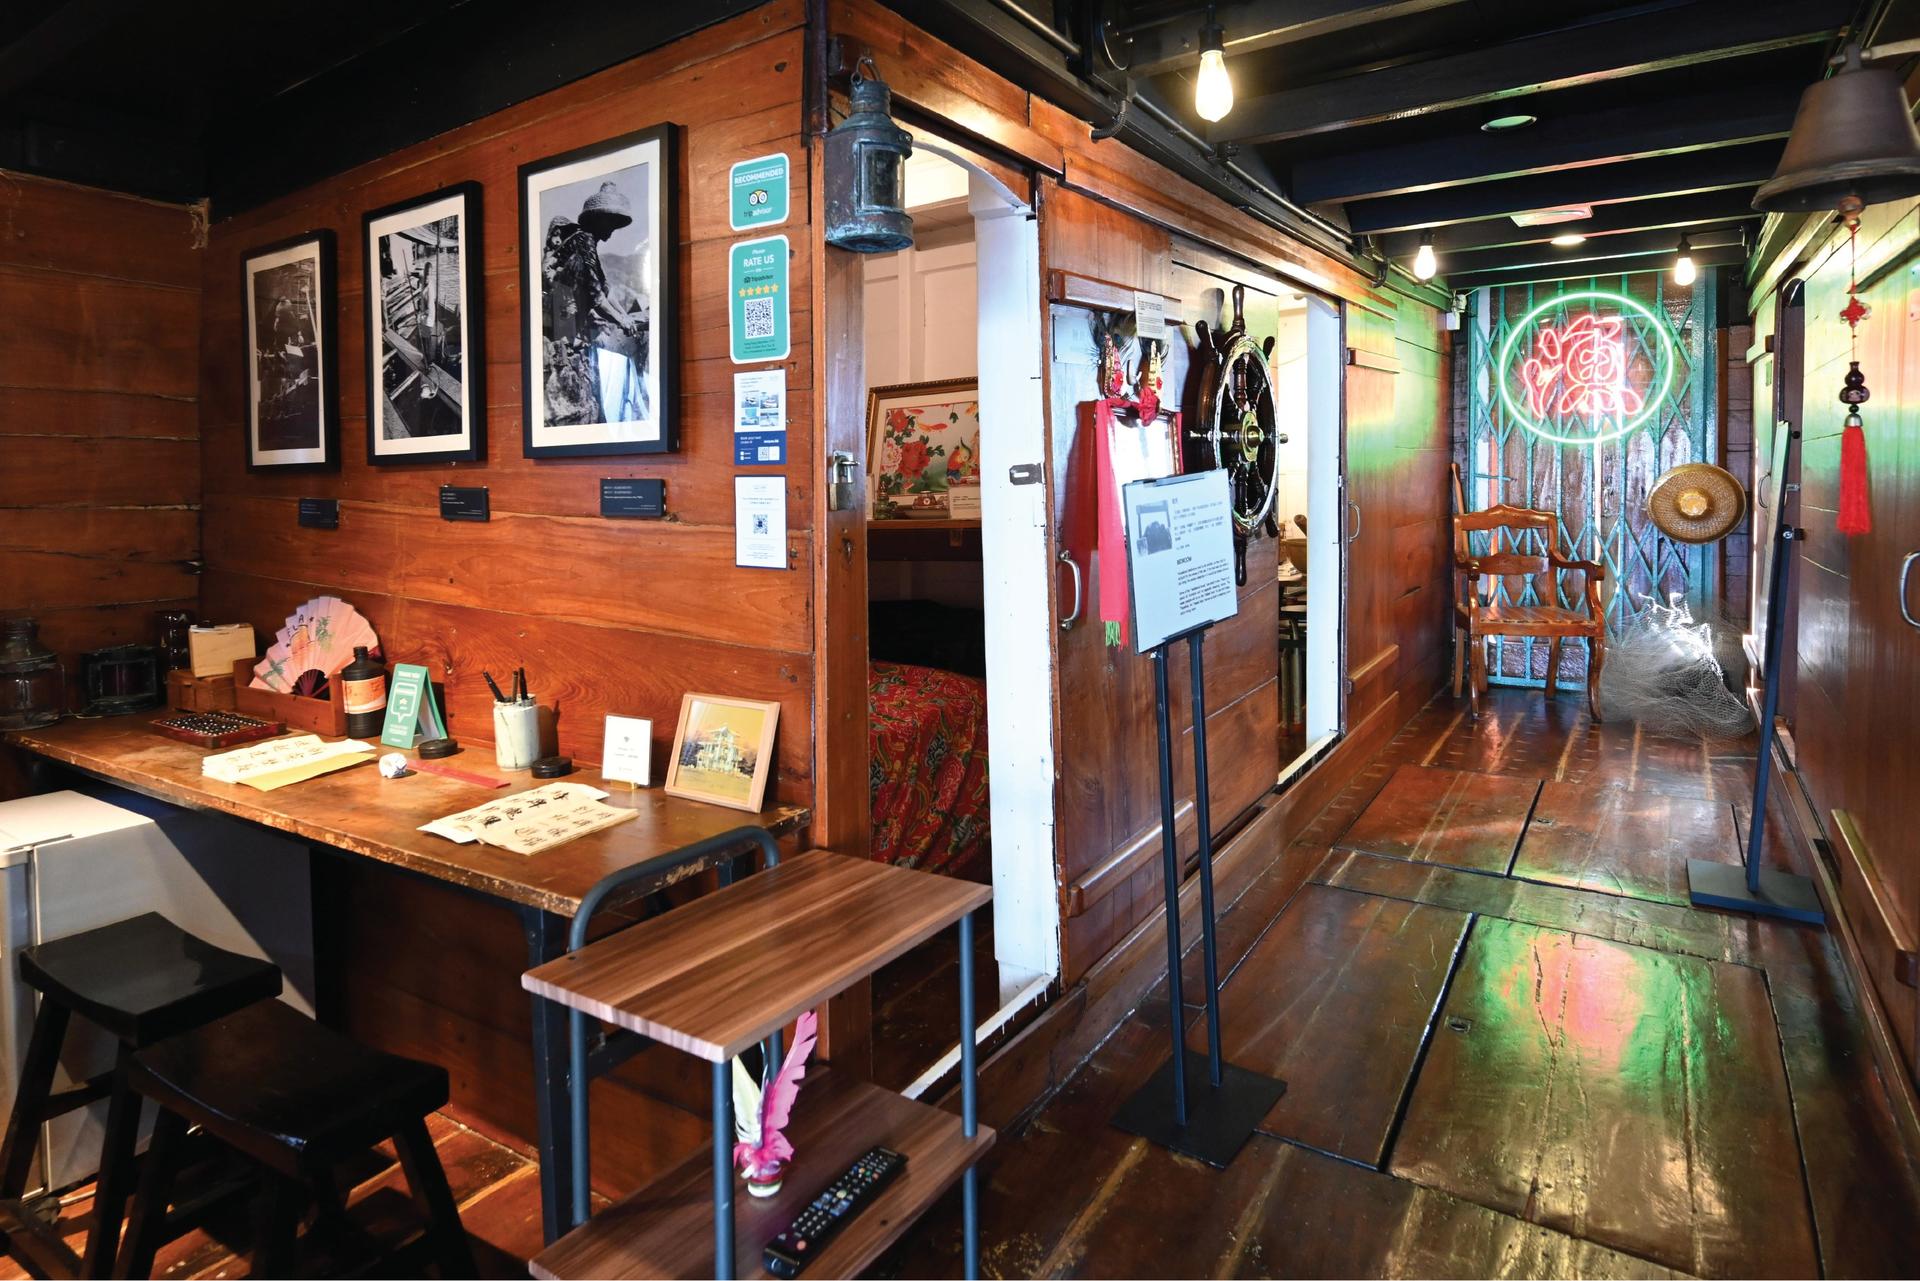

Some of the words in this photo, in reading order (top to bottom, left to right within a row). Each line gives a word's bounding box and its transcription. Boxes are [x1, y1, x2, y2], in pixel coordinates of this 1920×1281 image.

[735, 168, 784, 184] RECOMMENDED
[743, 256, 762, 268] RATE
[763, 254, 775, 264] US
